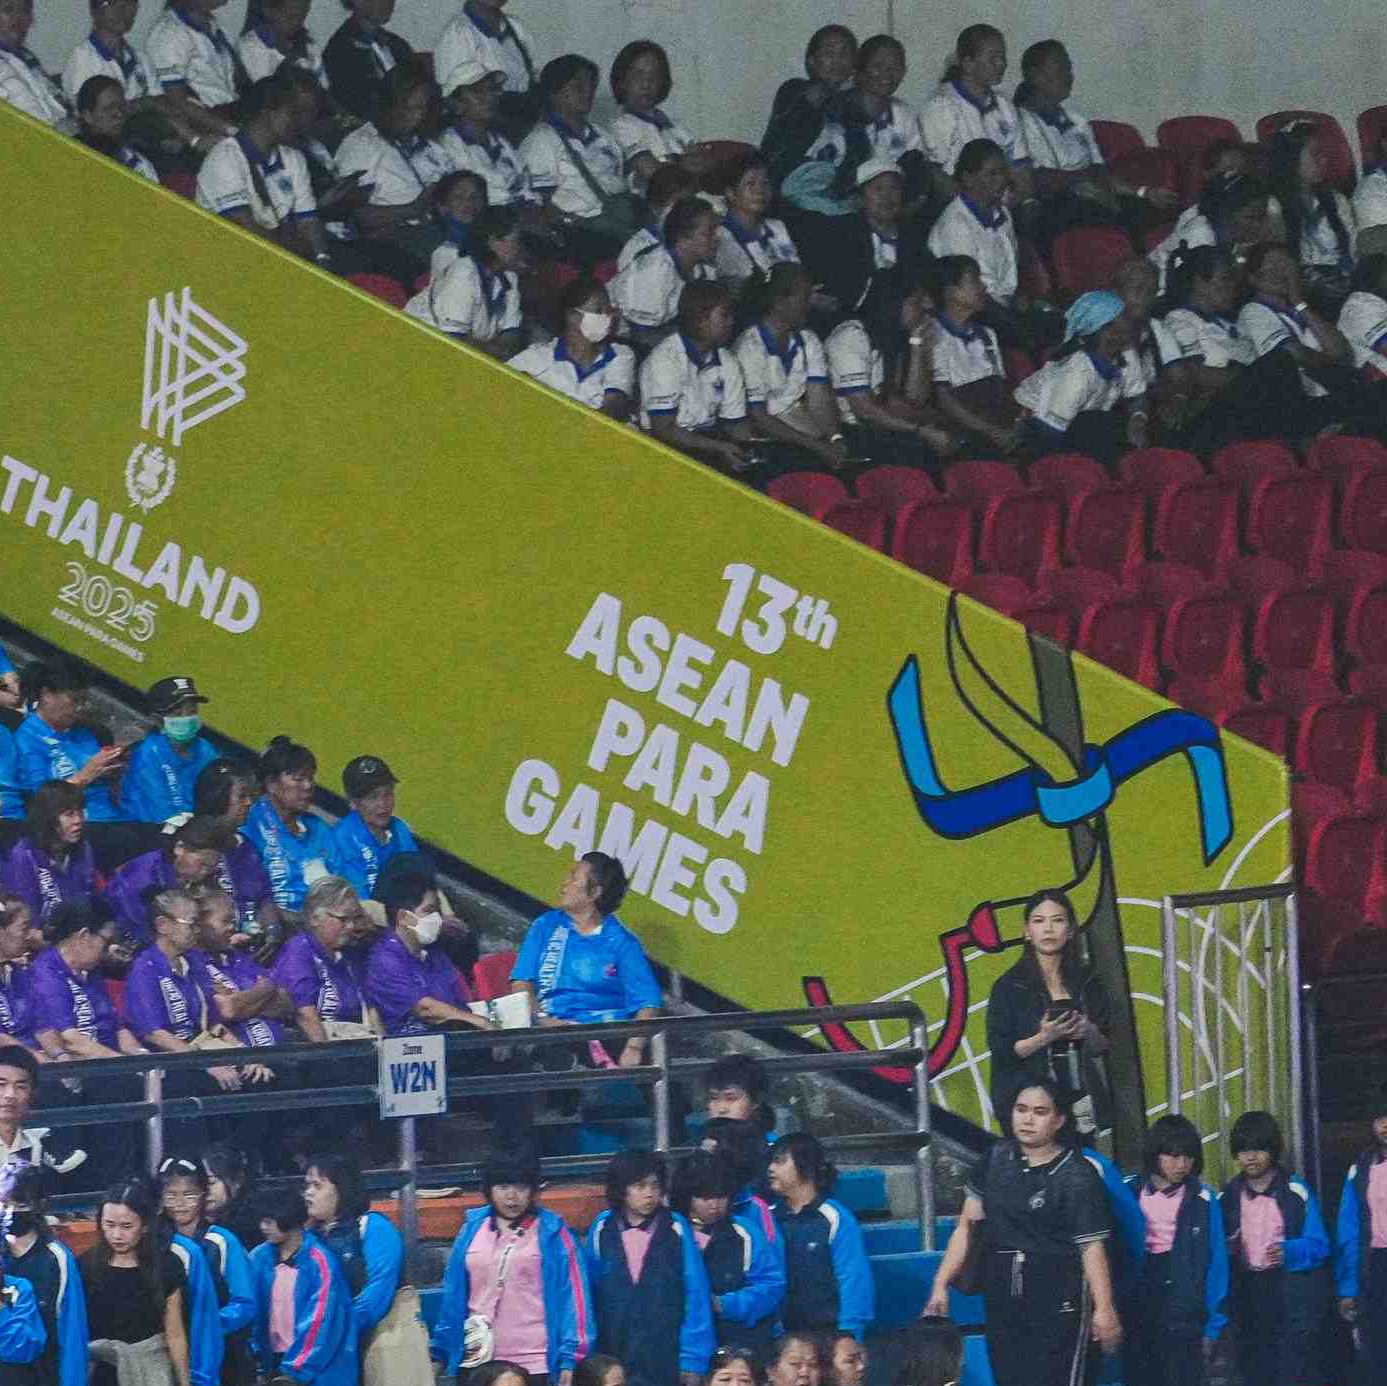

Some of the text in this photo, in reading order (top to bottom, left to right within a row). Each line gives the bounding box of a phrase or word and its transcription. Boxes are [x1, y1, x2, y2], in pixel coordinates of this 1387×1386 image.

[0, 455, 261, 634] THAILAND
[58, 561, 159, 642] 2025
[715, 562, 839, 655] 13th
[564, 592, 812, 767] ASEAN
[504, 758, 749, 936] GAMES
[586, 698, 771, 856] PARA
[390, 1060, 437, 1095] W2N
